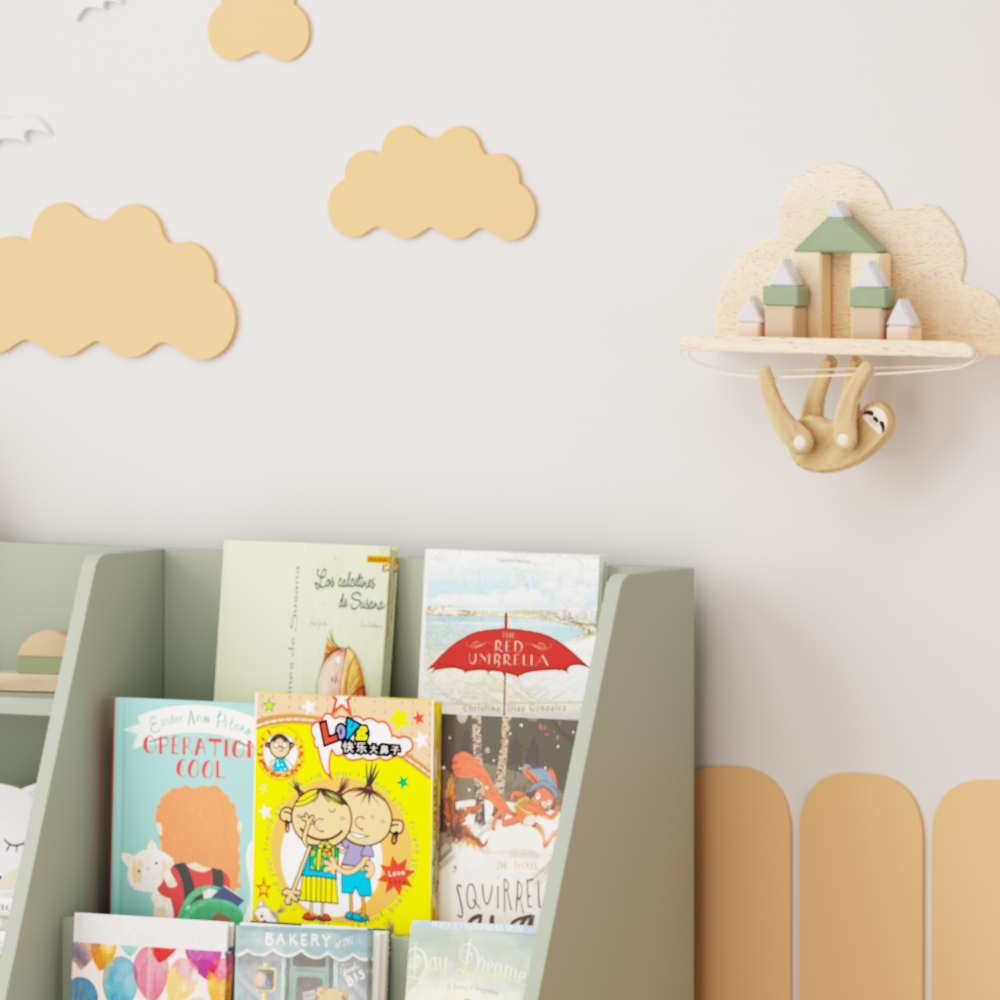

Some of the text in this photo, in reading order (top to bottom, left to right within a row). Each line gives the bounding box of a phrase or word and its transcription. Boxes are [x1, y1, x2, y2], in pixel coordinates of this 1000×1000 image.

[314, 567, 376, 590] Los calcetines
[338, 591, 385, 611] de Susana
[494, 639, 524, 653] RED
[467, 652, 550, 668] UMBRELLA
[187, 710, 210, 726] Ann
[319, 717, 370, 747] LOVE
[176, 758, 226, 779] COOL
[387, 869, 406, 878] Love
[264, 931, 331, 949] BAKERY
[405, 942, 449, 985] Day
